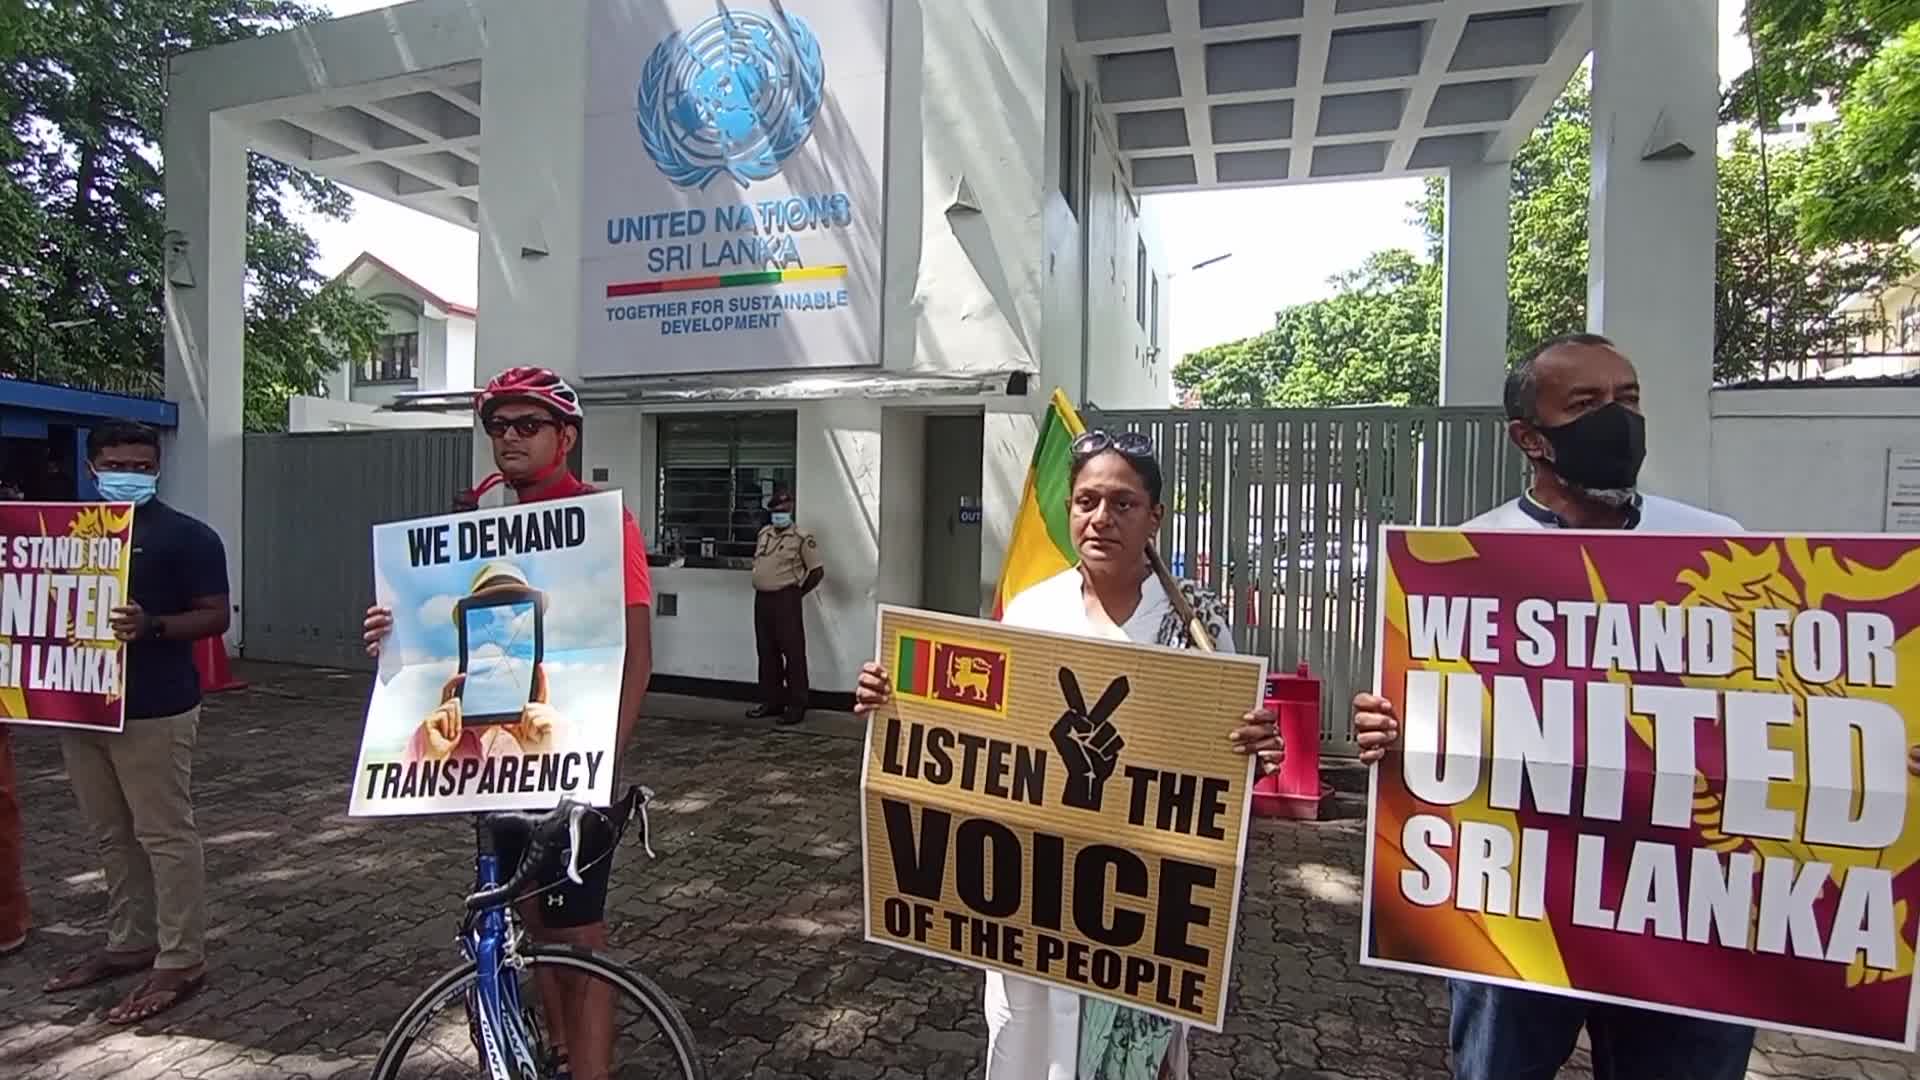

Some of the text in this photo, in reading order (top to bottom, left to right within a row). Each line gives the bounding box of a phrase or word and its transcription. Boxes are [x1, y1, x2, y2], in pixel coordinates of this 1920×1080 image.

[607, 193, 850, 244] UNITED NATIONS
[647, 236, 803, 272] SRI LANKA
[606, 291, 848, 321] TOGETHER FOR SUSTAINABLE
[661, 314, 781, 335] DEVELOPMENT
[12, 536, 84, 569] STAND
[88, 538, 121, 569] FOR
[408, 506, 585, 567] WE DEMAND
[0, 573, 122, 641] NITED
[0, 643, 119, 695] RI LANKA
[1406, 595, 1896, 686] WE STAND FOR
[366, 752, 604, 799] TRANSPARENCY
[882, 719, 1230, 841] LISTEN THE
[1403, 669, 1907, 848] UNITED
[881, 798, 1217, 967] VOICE
[1400, 815, 1896, 969] SRI LANKA
[884, 898, 1206, 1015] OF THE PEOPLE
